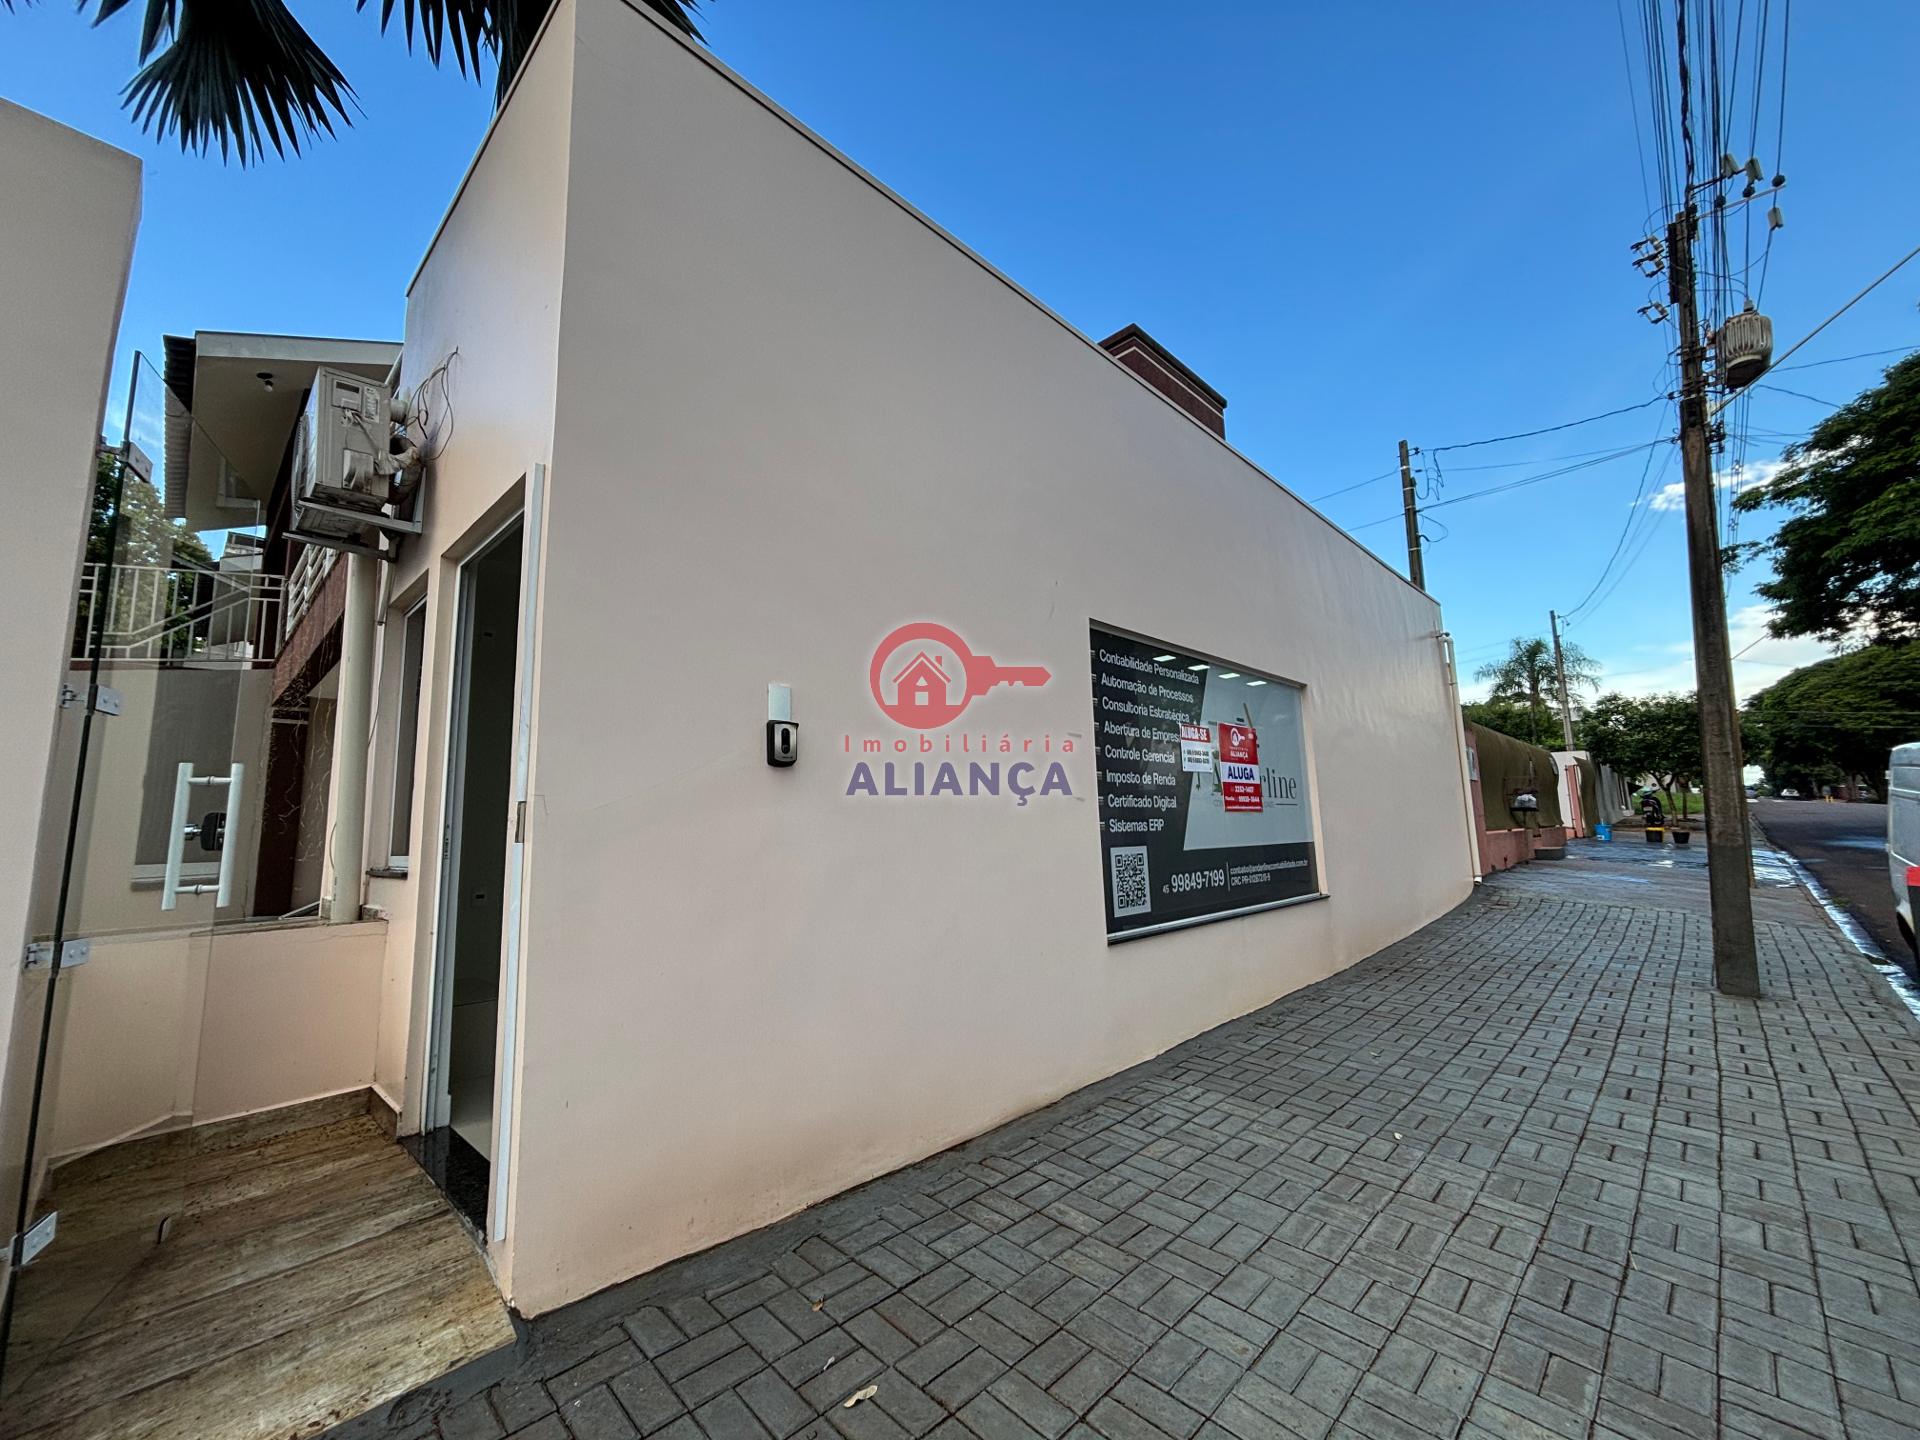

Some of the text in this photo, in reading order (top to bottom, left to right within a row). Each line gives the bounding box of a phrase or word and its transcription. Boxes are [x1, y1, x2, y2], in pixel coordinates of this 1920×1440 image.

[1100, 649, 1199, 684] Contabilidade Personalizada
[1101, 673, 1194, 703] Automação de Processos
[1102, 696, 1190, 725] Consultoria Estratégica
[1104, 721, 1140, 738] Abertura
[1141, 725, 1151, 739] de
[1105, 744, 1140, 760] Controle
[1142, 748, 1175, 764] Gerencial
[1106, 769, 1176, 787] Imposto de Renda
[1228, 765, 1255, 781] ALUGA
[1107, 794, 1177, 812] Certificado Digital
[1109, 818, 1165, 833] Sistemas ERP
[1162, 884, 1170, 894] 45
[1171, 869, 1225, 893] 99849-7199
